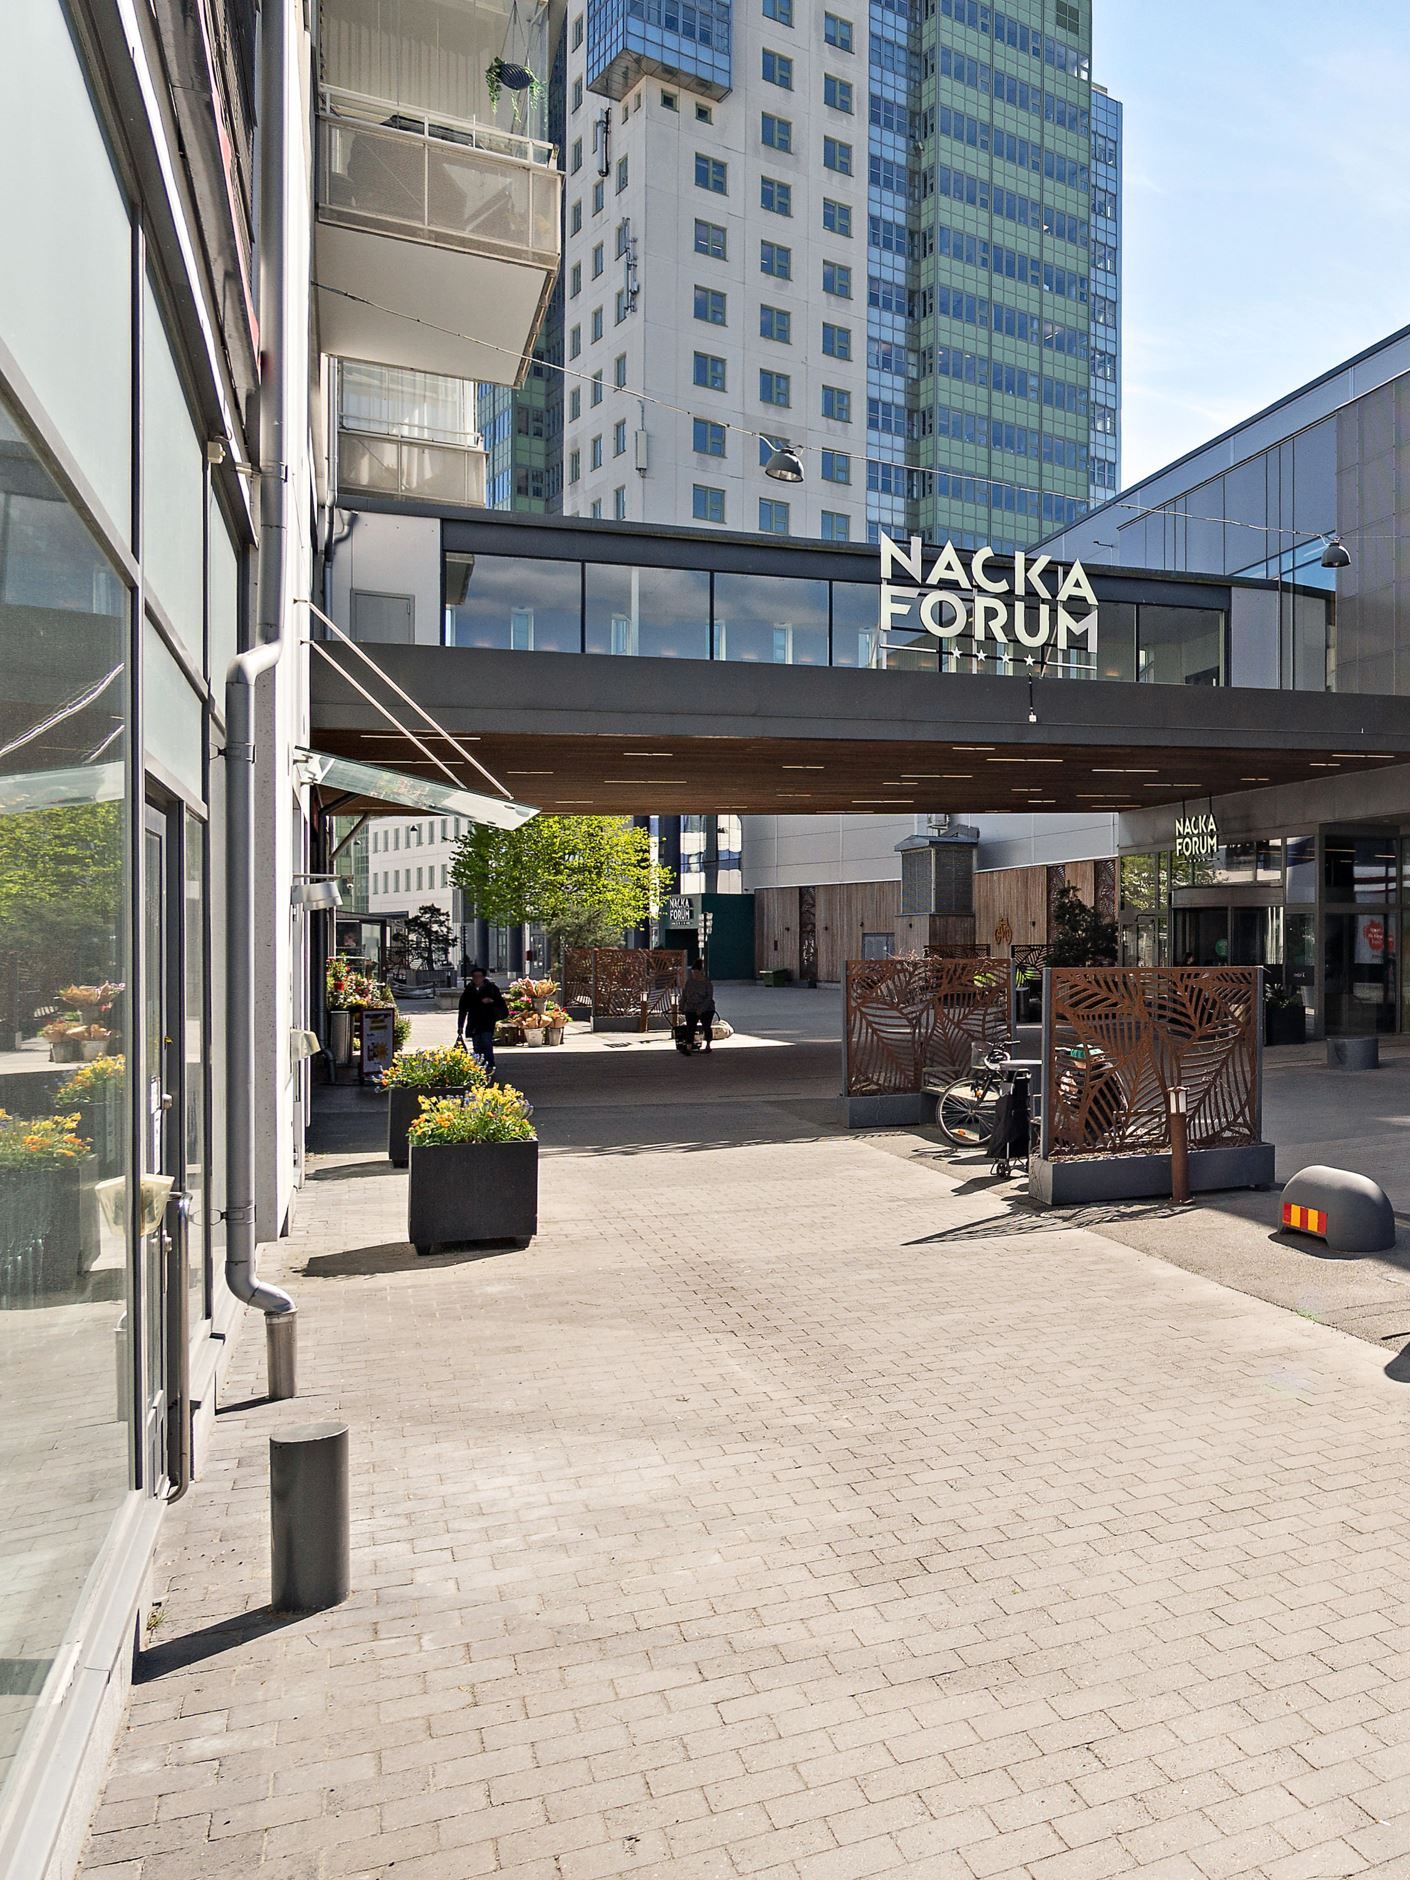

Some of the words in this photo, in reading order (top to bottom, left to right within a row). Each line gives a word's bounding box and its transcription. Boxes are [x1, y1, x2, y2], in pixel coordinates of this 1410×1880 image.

[880, 530, 1099, 606] NACKA
[880, 583, 1099, 654] FORUM
[1175, 814, 1217, 837] NACKA
[1176, 834, 1217, 857] FORUM
